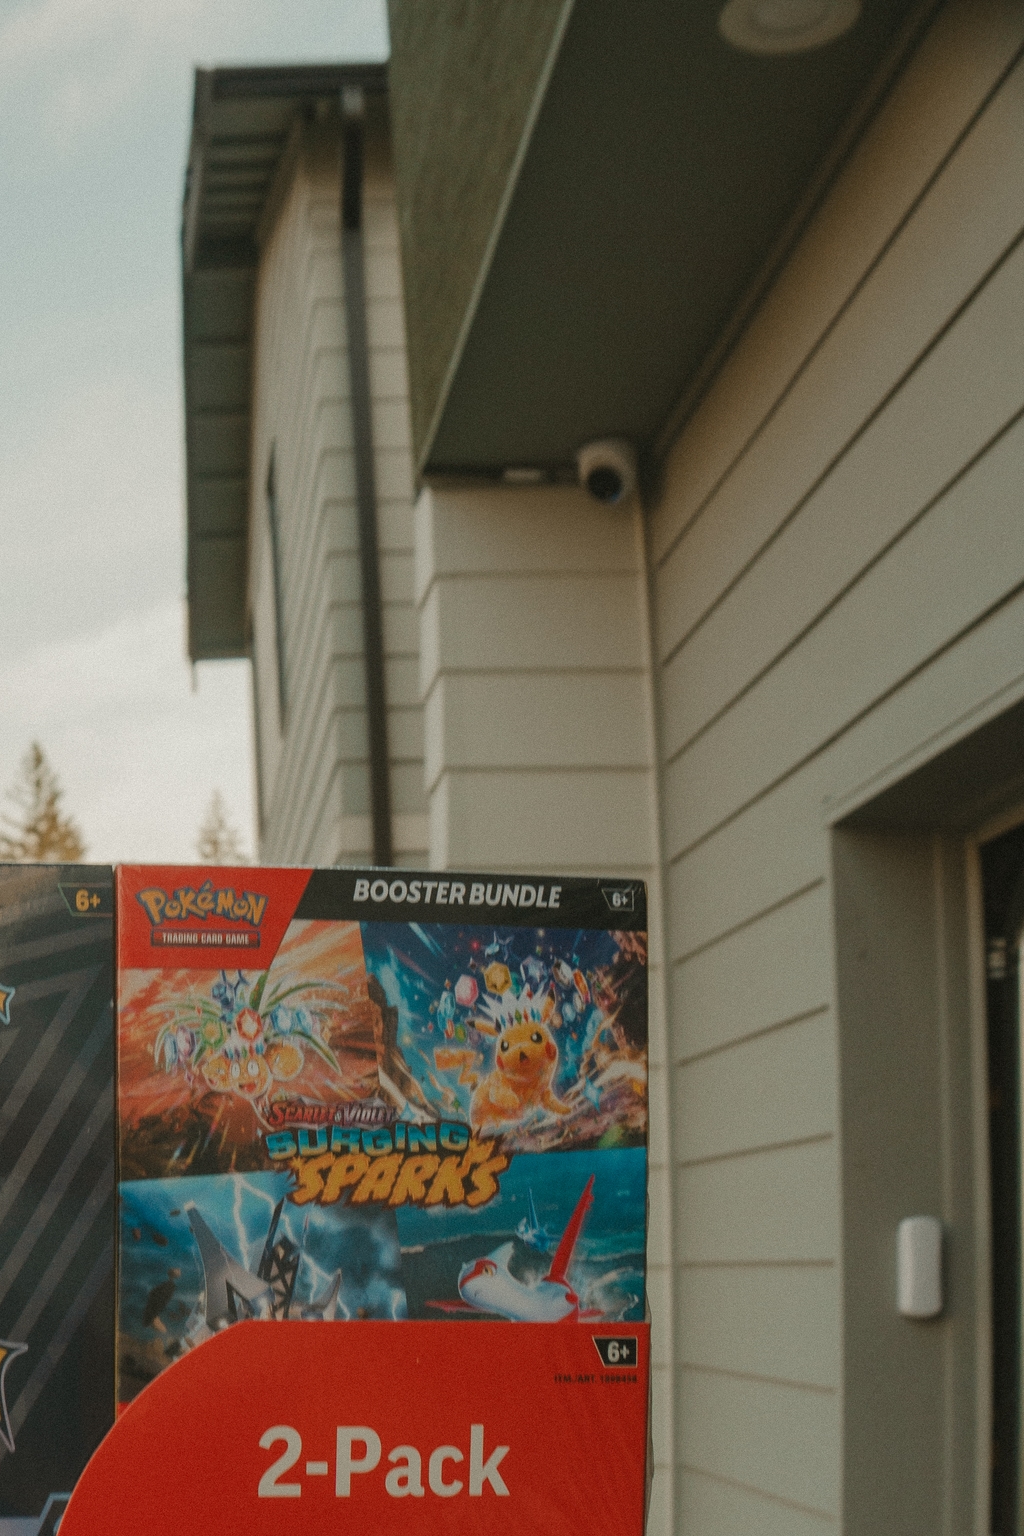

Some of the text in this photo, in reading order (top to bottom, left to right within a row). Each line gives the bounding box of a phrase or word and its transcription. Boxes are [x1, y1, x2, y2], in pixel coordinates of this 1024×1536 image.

[76, 889, 101, 912] 6+
[353, 878, 562, 909] BOOSTER BUNDLE
[612, 892, 628, 907] 6+
[162, 932, 250, 945] TRADING CARD GAME
[266, 1121, 470, 1160] SURGING
[291, 1137, 509, 1207] SPARKS
[607, 1340, 630, 1363] 6+
[257, 1423, 511, 1498] 2-Pack
